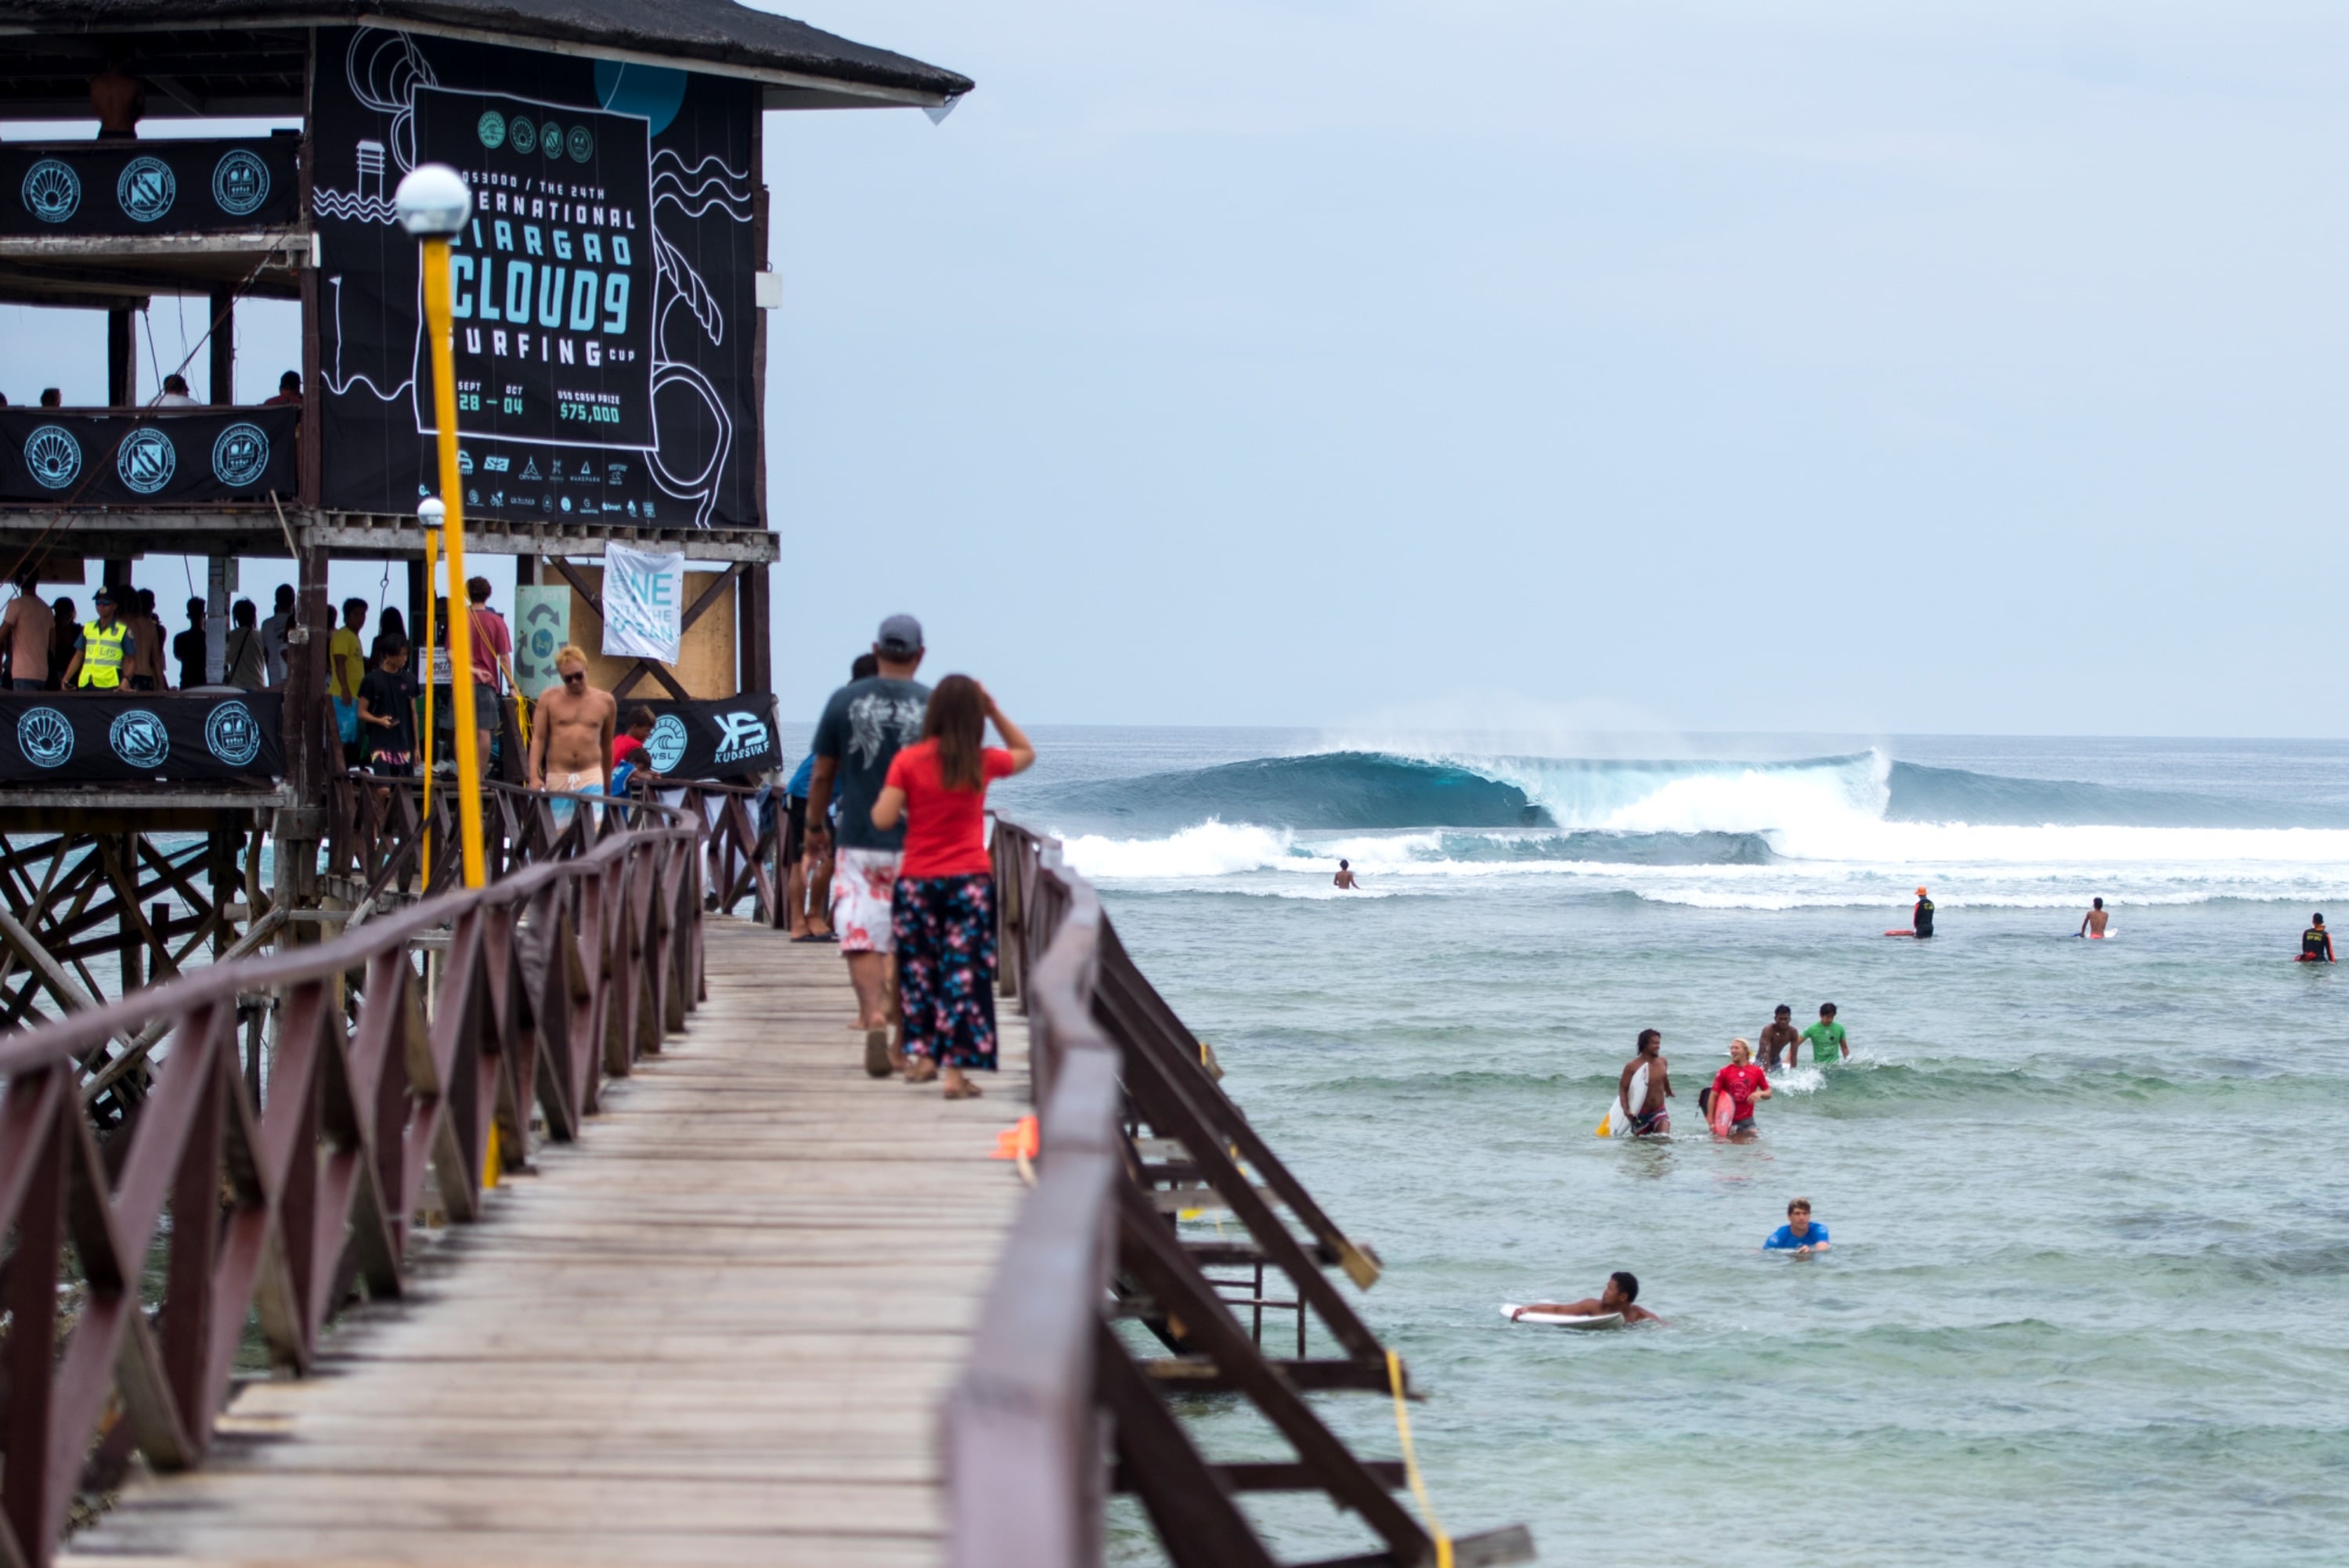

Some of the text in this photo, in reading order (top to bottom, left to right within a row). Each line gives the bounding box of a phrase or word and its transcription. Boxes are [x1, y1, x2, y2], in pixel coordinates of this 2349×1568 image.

[539, 181, 563, 196] THE
[571, 186, 604, 200] 24TH
[470, 192, 636, 229] ERNATIONAL
[449, 254, 630, 334] CLOUD9
[609, 348, 635, 362] CUP
[458, 380, 523, 395] SEPT OCT
[459, 394, 480, 411] 28
[503, 398, 523, 415] 04
[575, 391, 596, 402] CASH
[597, 393, 620, 405] PRIZE
[560, 402, 619, 423] $75,000
